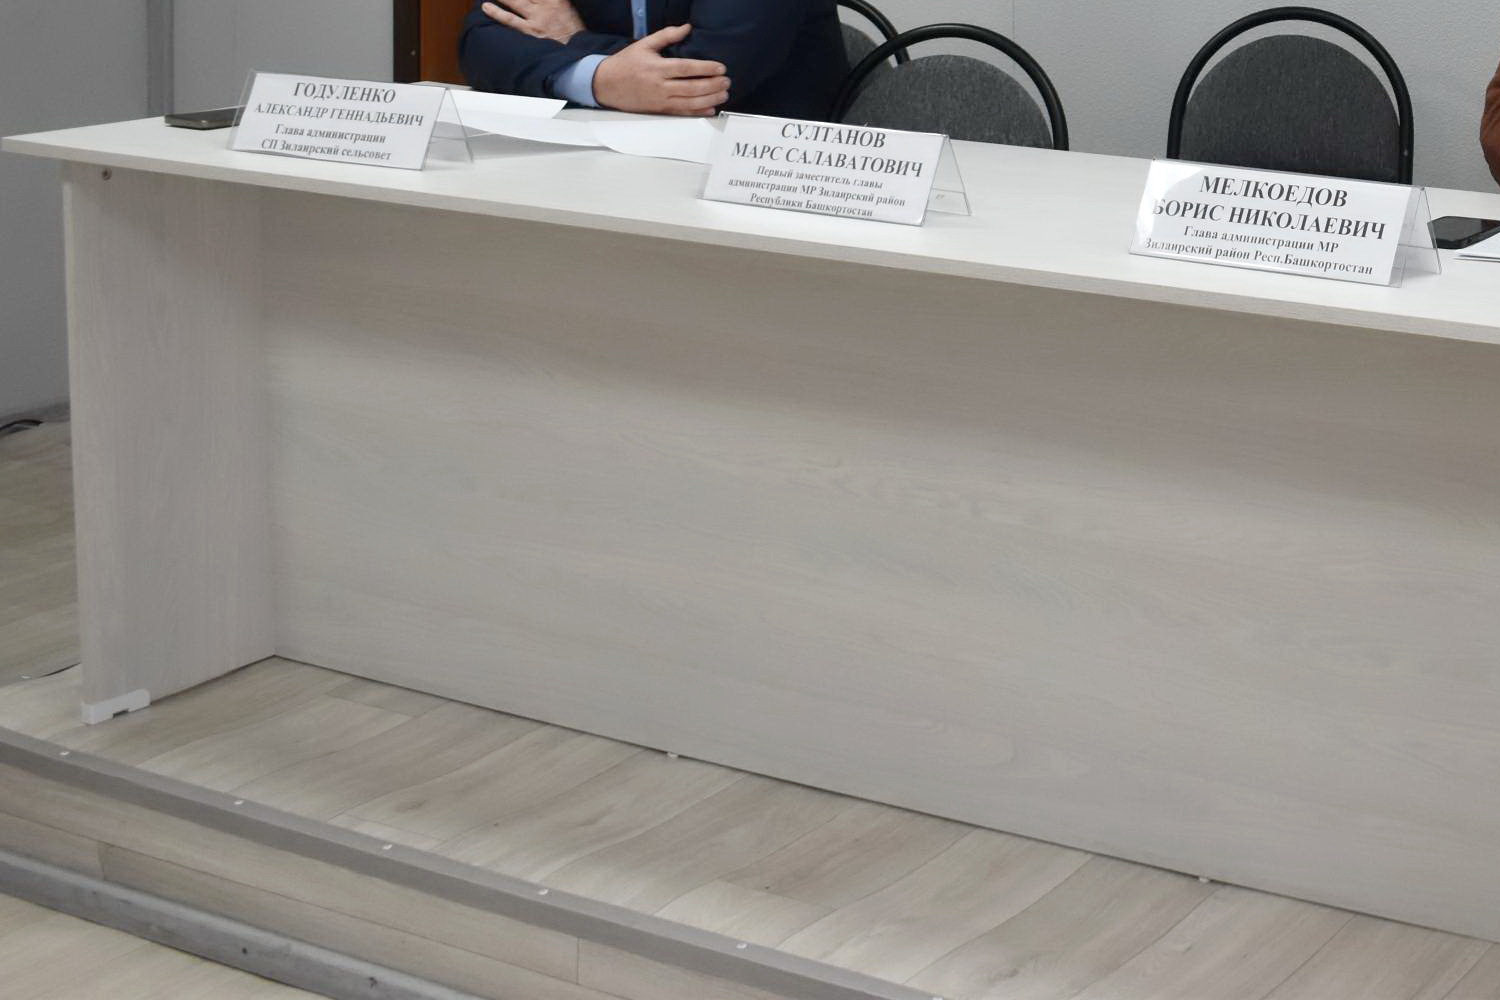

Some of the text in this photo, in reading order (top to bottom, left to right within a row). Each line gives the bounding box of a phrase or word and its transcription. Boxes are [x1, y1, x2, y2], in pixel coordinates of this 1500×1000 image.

[294, 82, 396, 104] ГОДУЛЕНКО
[254, 102, 424, 127] АЛЕКСАНДР ГЕННАДЬЕВИЧ
[275, 123, 387, 144] Глава администрации
[781, 122, 886, 149] СУЛТАНОВ
[261, 138, 392, 161] СП Зилаирский сельсовет
[731, 141, 923, 178] МАРС САЛАВАТОВИЧ
[757, 165, 884, 190] Первый заместитель главы
[728, 177, 906, 207] администрации МР Зилаирский район
[1200, 175, 1349, 208] МЕЛКОЕДОВ
[750, 192, 873, 217] Республики Башкортостан
[1152, 198, 1386, 240] БОРИС НИКОЛАЕВИЧ
[1184, 225, 1339, 254] Глава администрации МР
[1215, 247, 1250, 260] район
